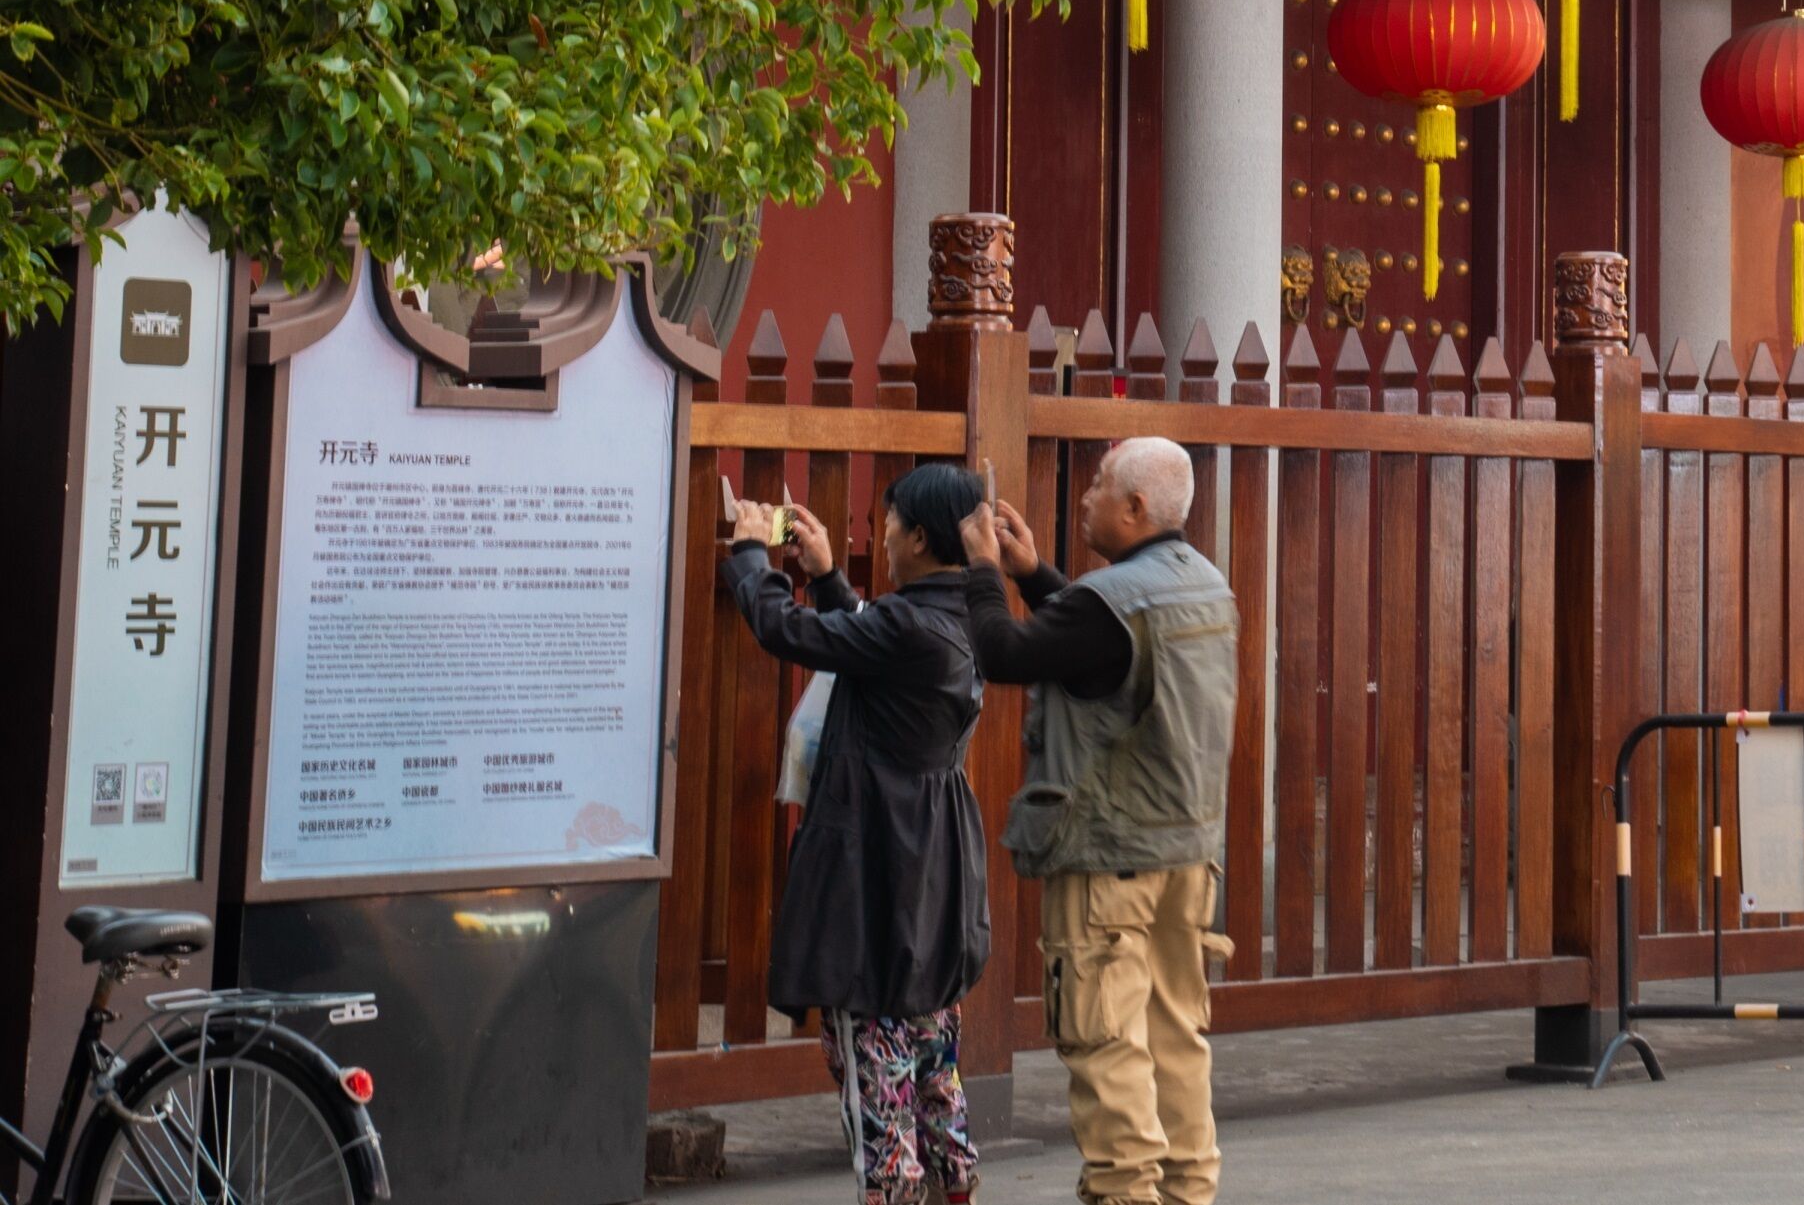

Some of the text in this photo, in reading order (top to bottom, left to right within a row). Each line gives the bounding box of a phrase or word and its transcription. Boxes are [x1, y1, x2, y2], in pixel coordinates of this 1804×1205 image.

[319, 440, 472, 467] 开元寺 KAIYUAN TEMPLE
[106, 406, 127, 571] KAIYUAN TEMPLE
[126, 406, 186, 656] 开元寺
[301, 758, 376, 773] 国家历史文化名城
[402, 756, 458, 770] 国家园林城市
[484, 752, 555, 766] 中国优秀旅游城市
[402, 784, 439, 798] 中国瓷都
[482, 780, 563, 795] 中国婚纱晚礼服名城
[300, 788, 356, 803] 中国著名侨乡
[298, 816, 392, 833] 中国民族民间艺术之乡
